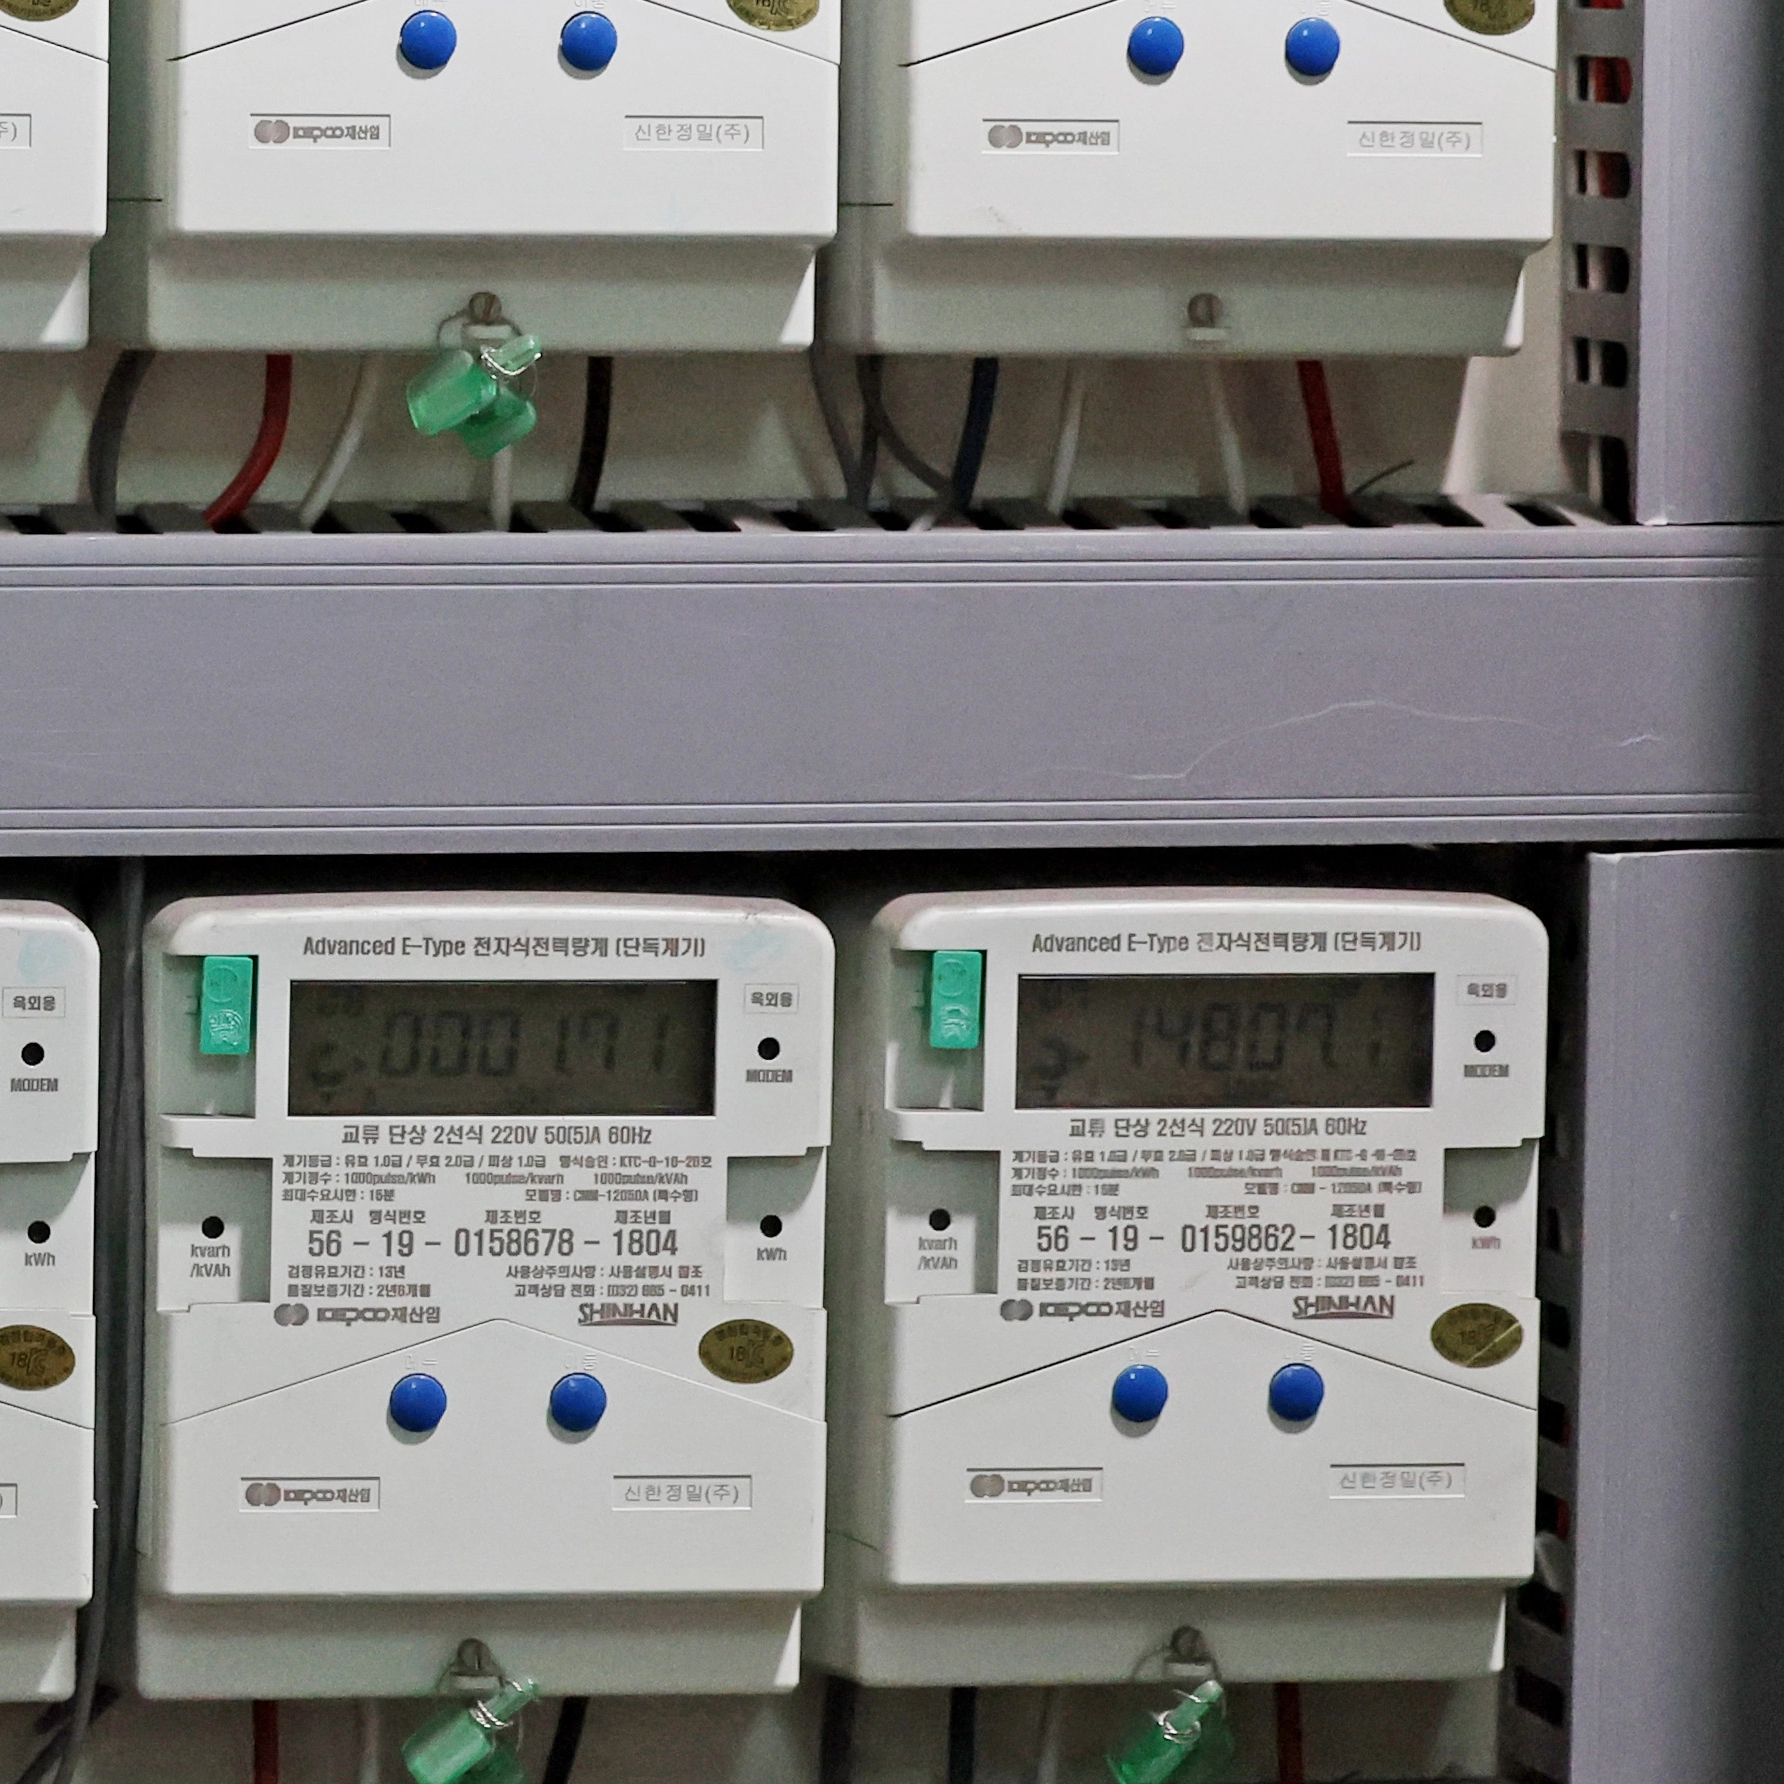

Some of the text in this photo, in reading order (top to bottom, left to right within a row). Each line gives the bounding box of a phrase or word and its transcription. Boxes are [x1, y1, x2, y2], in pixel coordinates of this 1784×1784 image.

[303, 937, 465, 957] Advanced E-Type
[1032, 933, 1189, 953] Advanced E-Type
[455, 1228, 678, 1256] 0158678 1804
[1328, 1223, 1391, 1250] 1804
